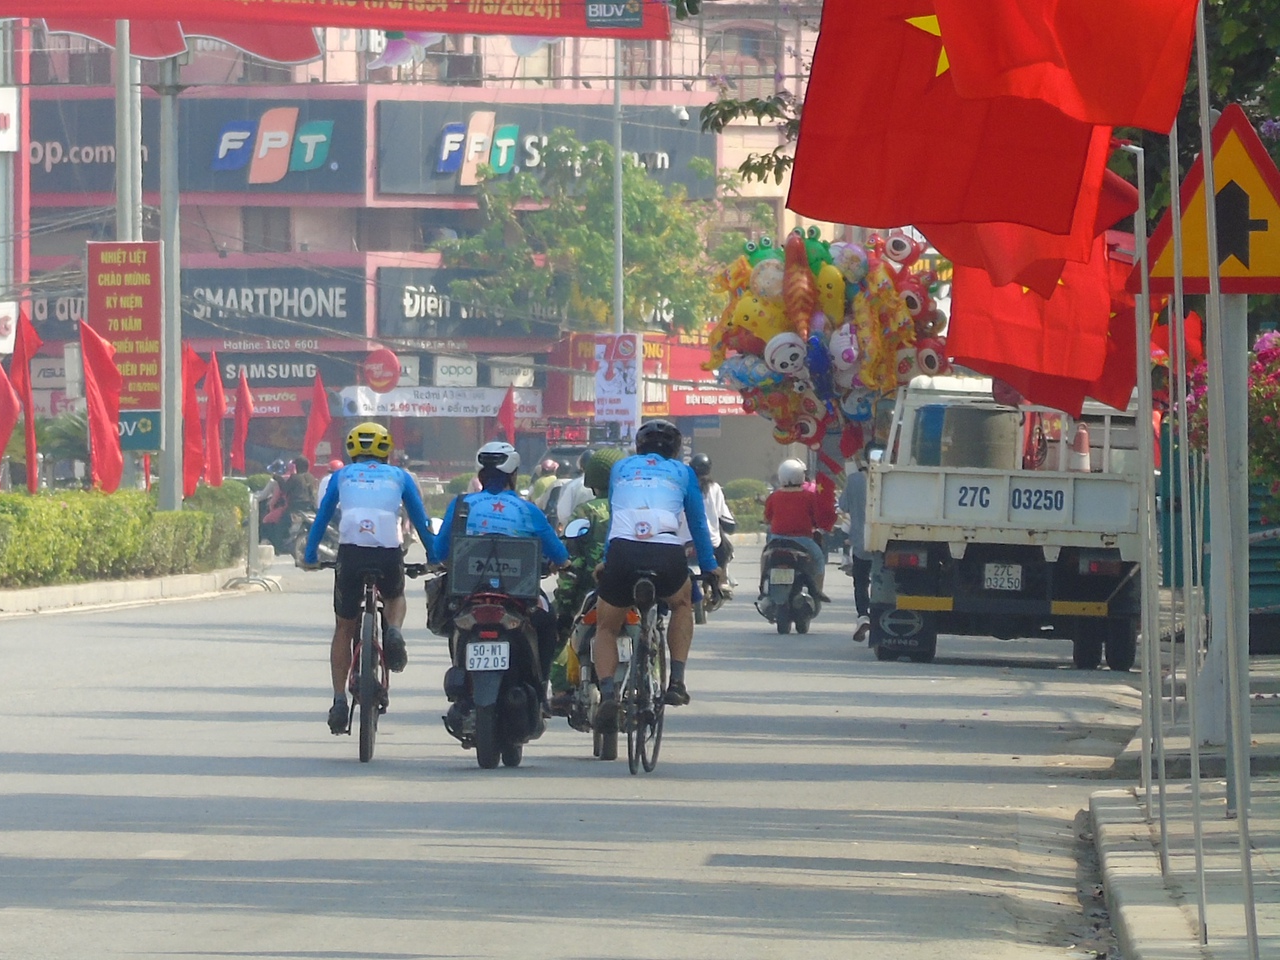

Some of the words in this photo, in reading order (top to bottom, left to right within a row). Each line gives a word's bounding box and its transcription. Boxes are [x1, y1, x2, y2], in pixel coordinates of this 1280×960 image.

[588, 4, 626, 18] BIDV
[219, 131, 327, 163] FPT
[441, 133, 515, 168] FPT
[101, 249, 127, 267] NHIỆT
[129, 249, 147, 267] LIỆT
[98, 271, 123, 286] CHÀO
[120, 293, 142, 311] NIỆM
[192, 286, 347, 319] SMARTPHONE
[108, 319, 119, 331] 70
[121, 316, 142, 331] NĂM
[140, 359, 158, 376] PHỦ
[226, 363, 318, 379] SAMSUNG
[440, 365, 473, 378] oppo
[958, 486, 990, 508] 27C
[1012, 488, 1065, 511] 03250
[993, 565, 1013, 577] 27C
[473, 644, 502, 656] 50-N1
